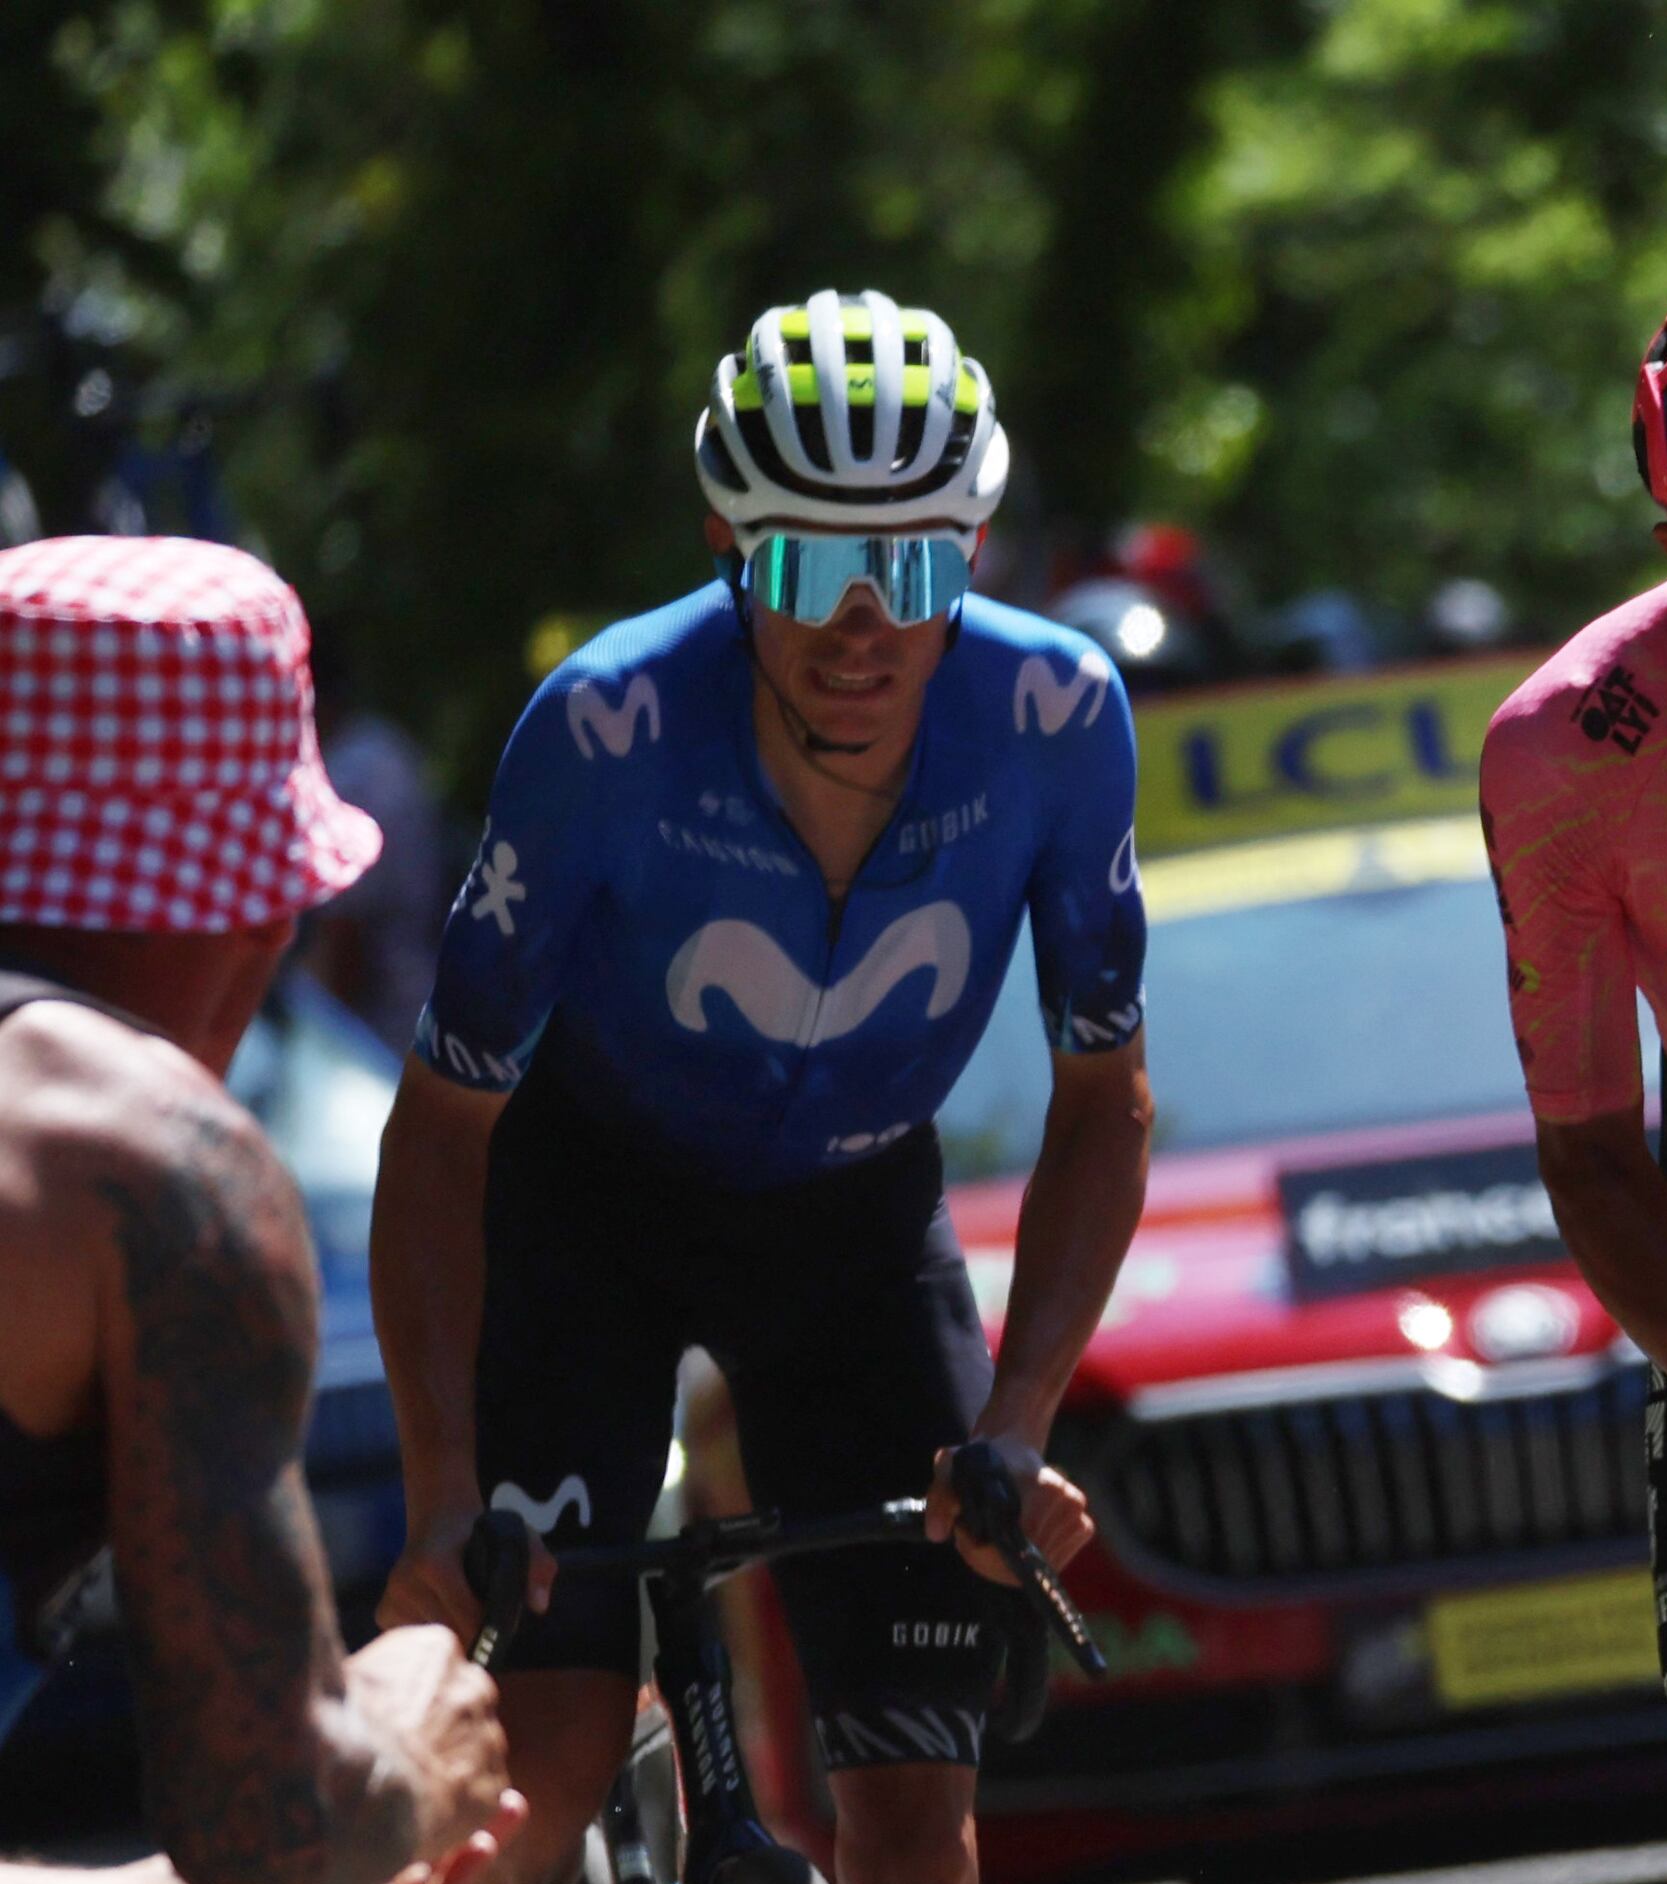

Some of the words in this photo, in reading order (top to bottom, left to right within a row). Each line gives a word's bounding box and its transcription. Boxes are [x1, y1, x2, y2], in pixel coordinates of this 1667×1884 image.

[1180, 696, 1480, 815] LCL
[899, 791, 990, 857] GOBIK
[891, 1620, 982, 1650] GOBIK
[682, 1680, 718, 1796] CANYON
